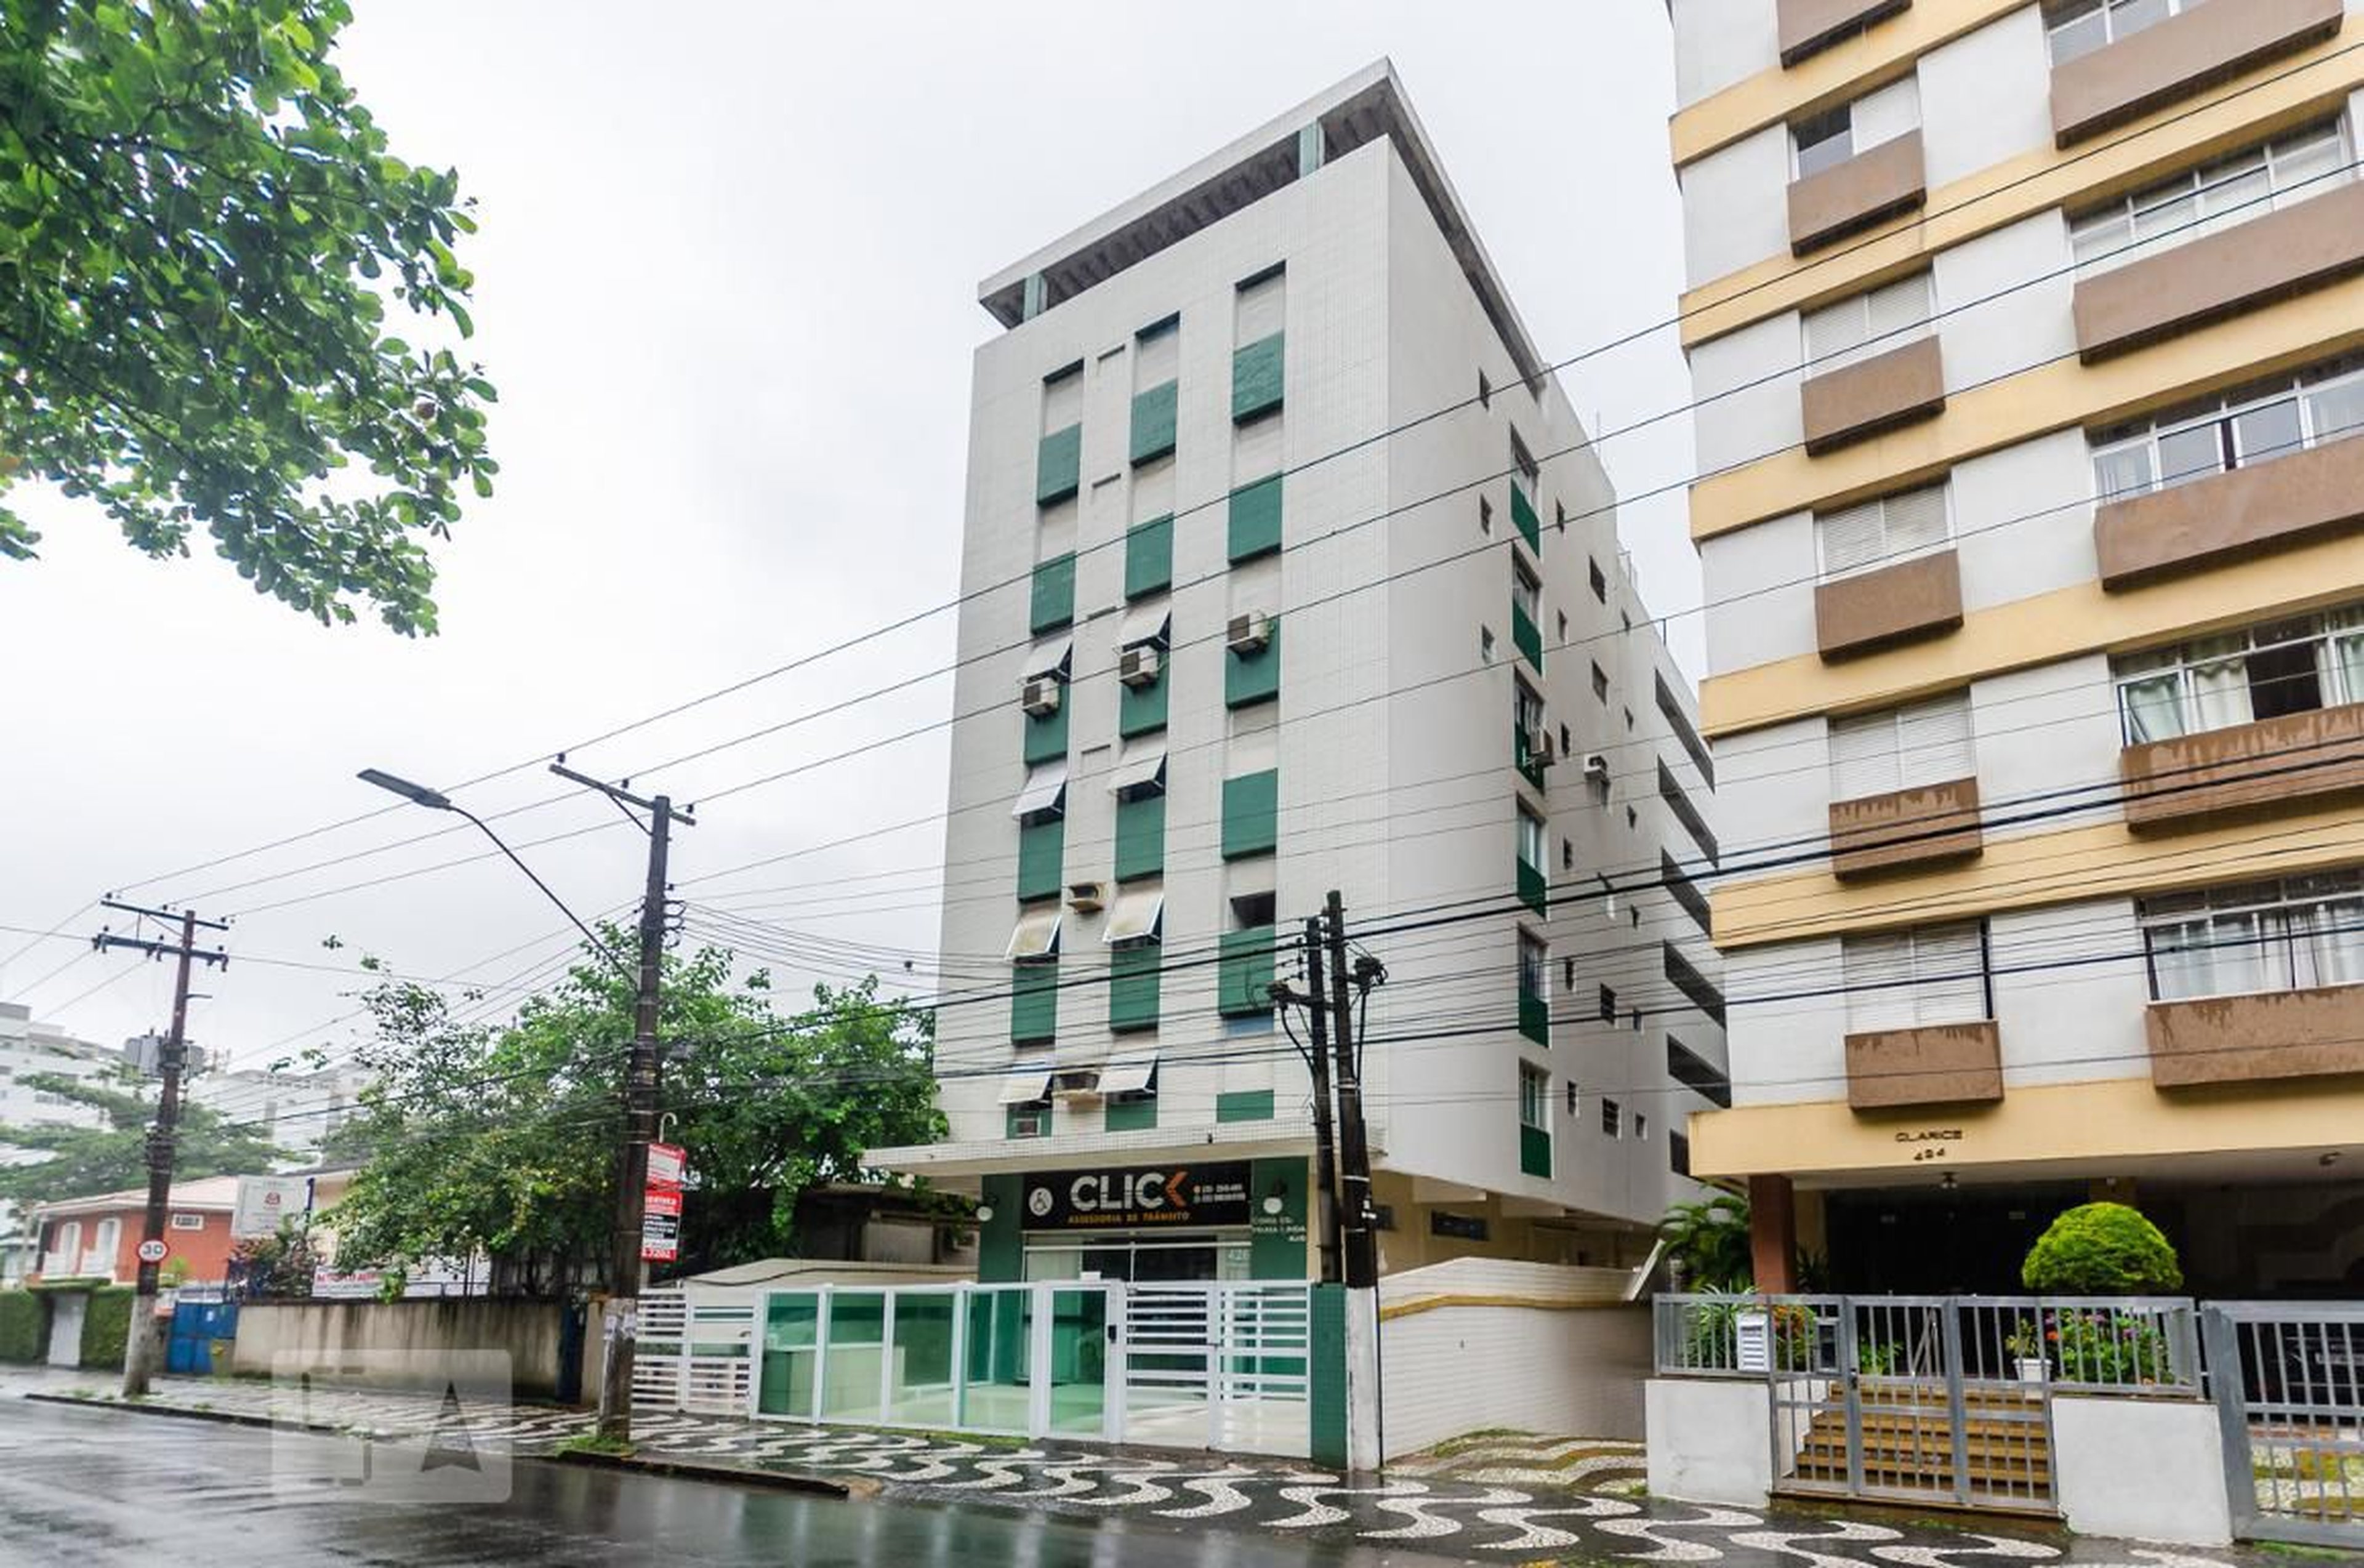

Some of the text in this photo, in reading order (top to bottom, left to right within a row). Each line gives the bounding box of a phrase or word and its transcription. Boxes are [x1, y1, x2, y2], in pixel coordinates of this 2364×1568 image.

[1895, 1130, 1963, 1143] CLARICE
[1914, 1148, 1945, 1161] 424
[142, 1244, 164, 1255] 30
